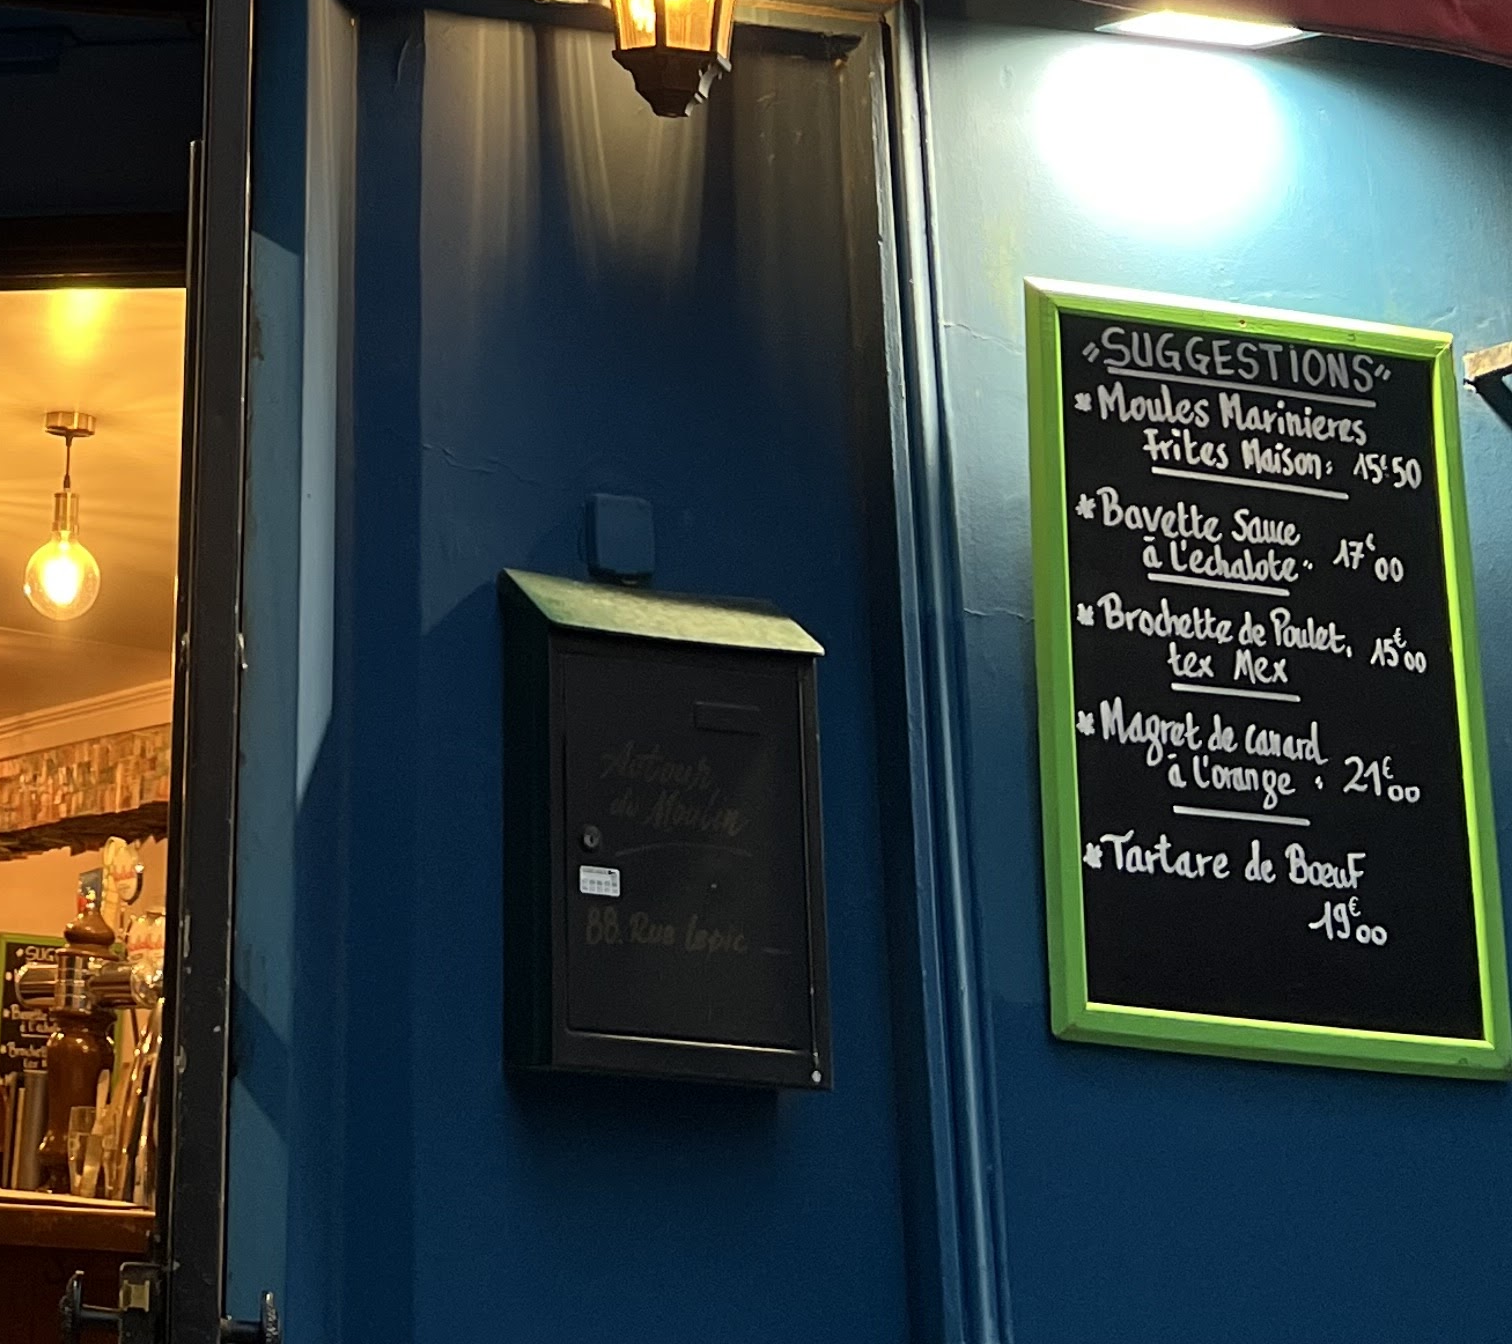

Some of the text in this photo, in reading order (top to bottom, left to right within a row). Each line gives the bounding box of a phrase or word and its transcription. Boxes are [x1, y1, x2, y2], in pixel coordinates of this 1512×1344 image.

[1097, 381, 1367, 446] Moules Marinieres
[1143, 427, 1229, 471] Frites
[1096, 486, 1300, 547] Bavette Sauce
[1096, 592, 1233, 645] Brochette
[1238, 610, 1267, 648] de
[1167, 641, 1215, 679] tex
[1233, 646, 1289, 685] Mex
[1100, 696, 1203, 767] Magret
[1207, 714, 1238, 754] de
[1099, 829, 1231, 880] Tartare
[1244, 839, 1277, 883] de
